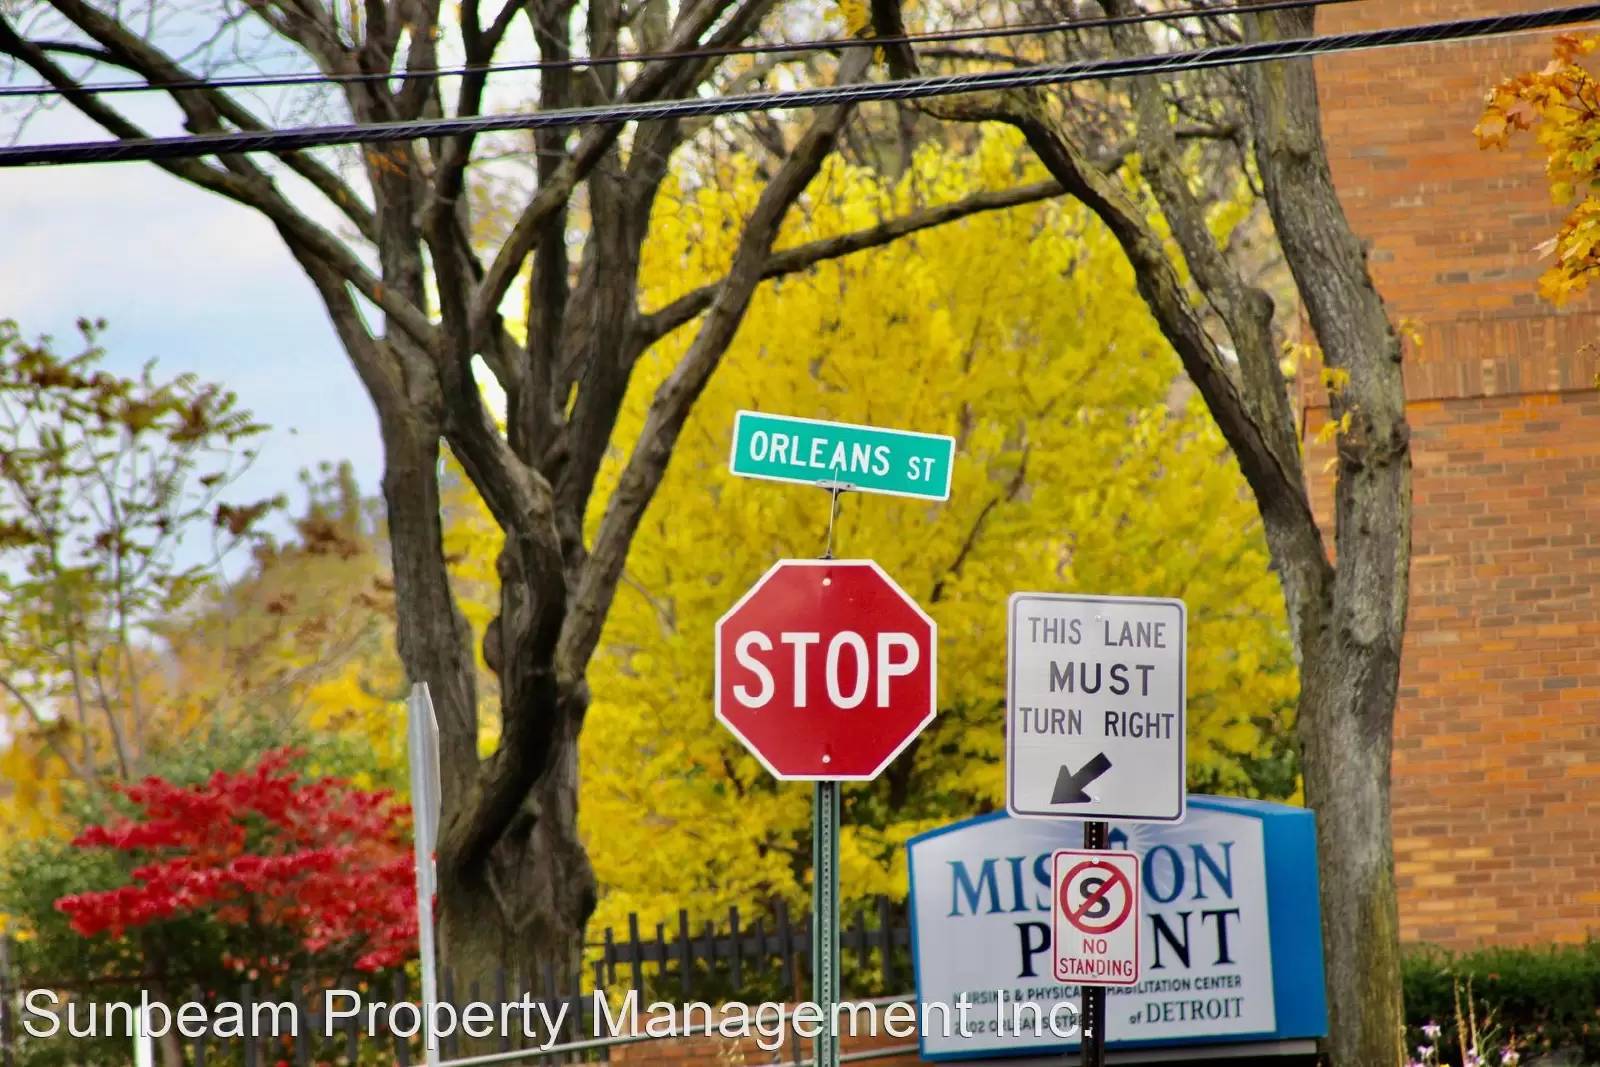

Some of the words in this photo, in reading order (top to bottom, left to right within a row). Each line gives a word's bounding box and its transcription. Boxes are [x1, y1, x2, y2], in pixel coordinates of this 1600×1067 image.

[749, 430, 891, 476] ORLEANS
[906, 456, 936, 481] ST
[1028, 617, 1082, 645] THIS
[1104, 620, 1167, 648] LANE
[733, 630, 920, 709] STOP
[1050, 661, 1155, 696] MUST
[1019, 707, 1082, 735] TURN
[1104, 711, 1175, 739] RIGHT
[946, 841, 1235, 917] MISON
[1014, 908, 1241, 978] PNT
[1083, 939, 1107, 954] NO
[1060, 958, 1133, 977] STANDING
[1028, 985, 1082, 1000] PHYSICA
[1195, 975, 1241, 990] CENTER
[1129, 1011, 1142, 1024] of
[1146, 996, 1244, 1024] DETROIT
